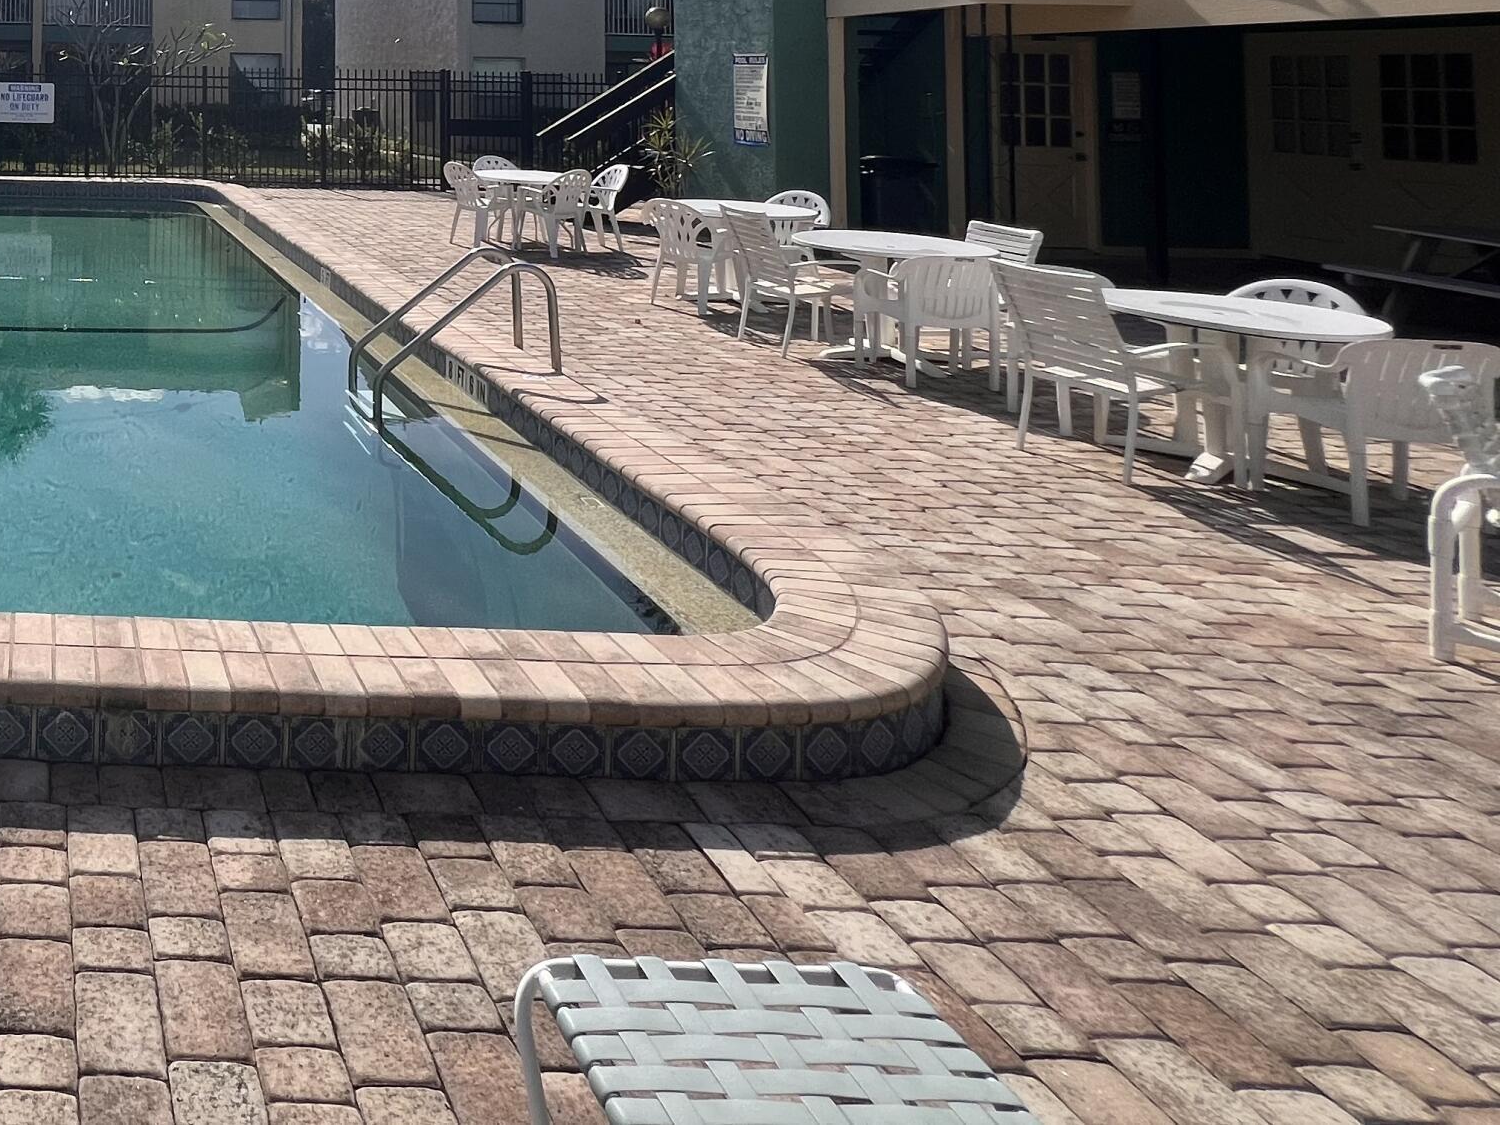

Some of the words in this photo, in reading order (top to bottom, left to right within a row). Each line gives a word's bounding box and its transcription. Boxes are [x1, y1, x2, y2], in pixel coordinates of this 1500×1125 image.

[0, 93, 10, 101] NO
[12, 93, 49, 101] LIFEGUARD
[21, 102, 40, 111] DUTY
[448, 360, 453, 379] 8
[457, 365, 465, 387] FT
